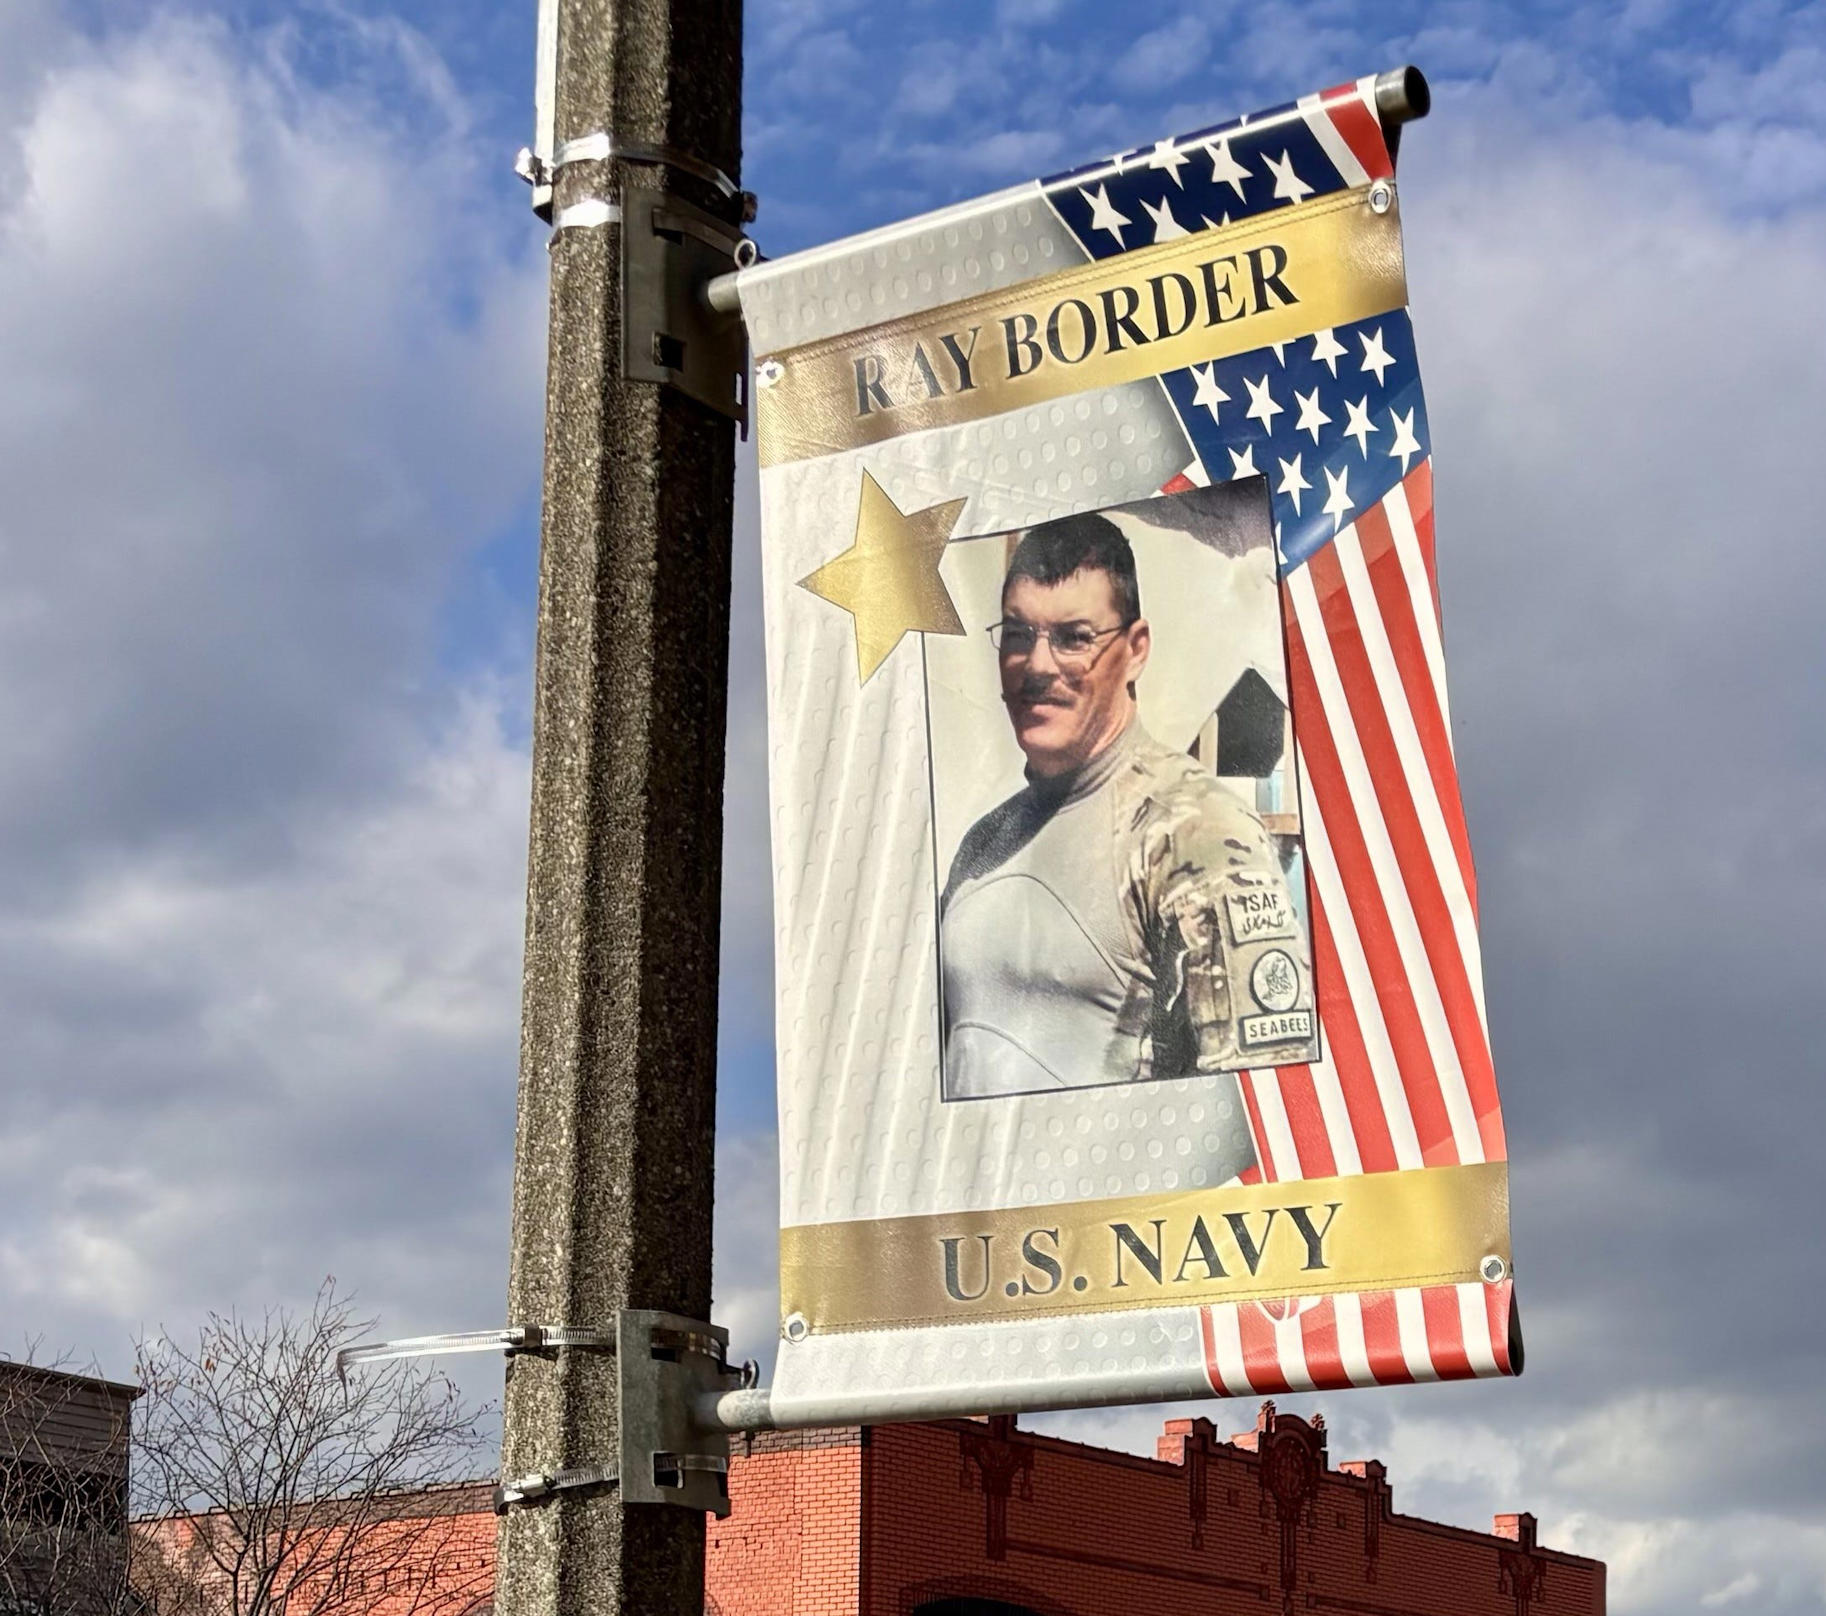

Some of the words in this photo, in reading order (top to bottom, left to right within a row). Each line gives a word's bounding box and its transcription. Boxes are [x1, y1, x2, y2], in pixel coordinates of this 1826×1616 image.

[852, 326, 982, 417] RAY
[999, 244, 1300, 380] BORDER
[1249, 1017, 1309, 1038] SEABEES
[940, 1228, 1089, 1302] U.S.
[1109, 1203, 1343, 1288] NAVY
